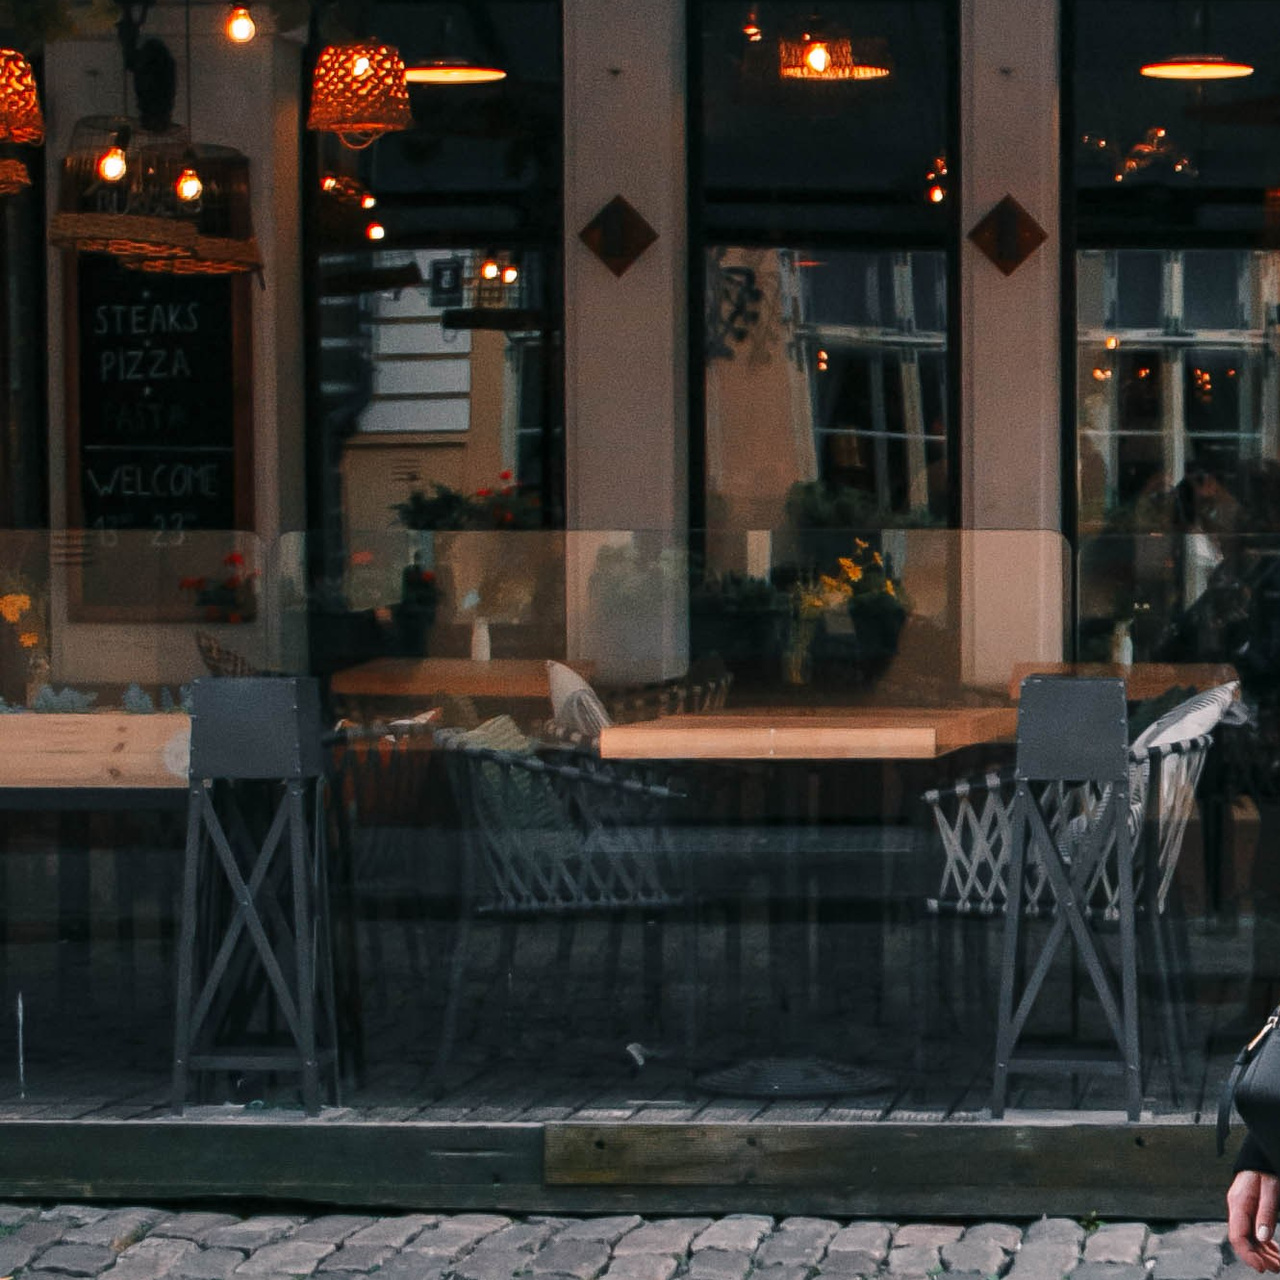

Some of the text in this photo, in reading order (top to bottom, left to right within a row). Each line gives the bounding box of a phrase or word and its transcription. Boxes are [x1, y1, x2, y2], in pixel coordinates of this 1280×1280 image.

[94, 301, 200, 335] STEAKS
[99, 346, 192, 383] PIZZA
[86, 463, 218, 497] WELCOME
